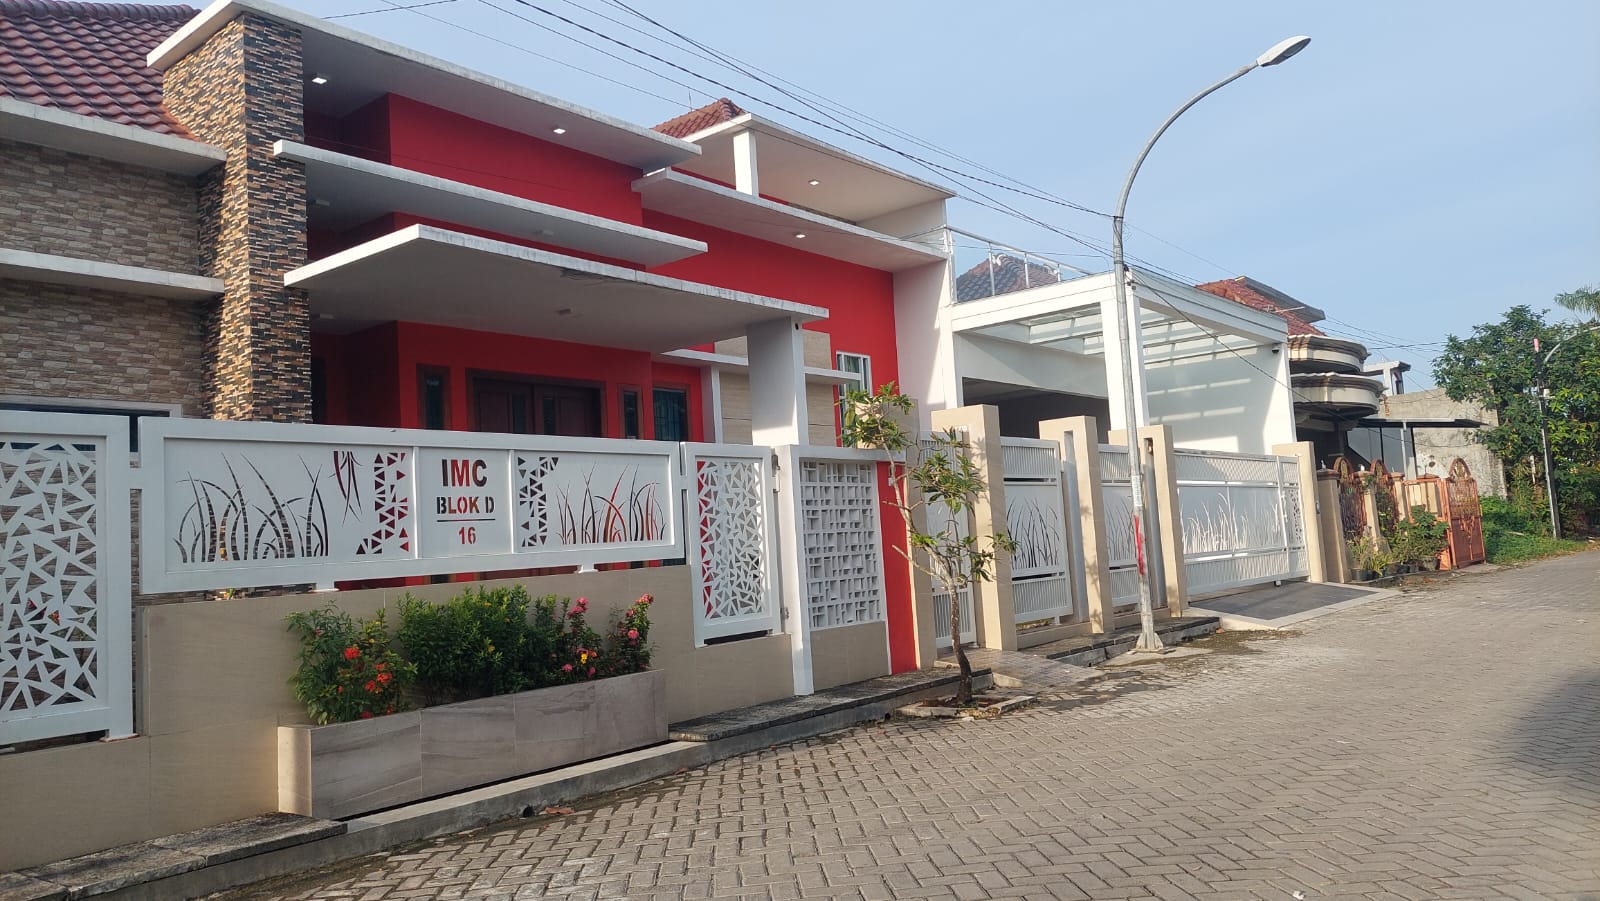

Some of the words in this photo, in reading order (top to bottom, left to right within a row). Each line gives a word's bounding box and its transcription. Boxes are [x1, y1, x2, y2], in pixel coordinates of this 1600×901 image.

[441, 458, 488, 487] IMC
[436, 496, 480, 514] BLOK
[485, 496, 495, 514] D
[458, 526, 477, 545] 16
